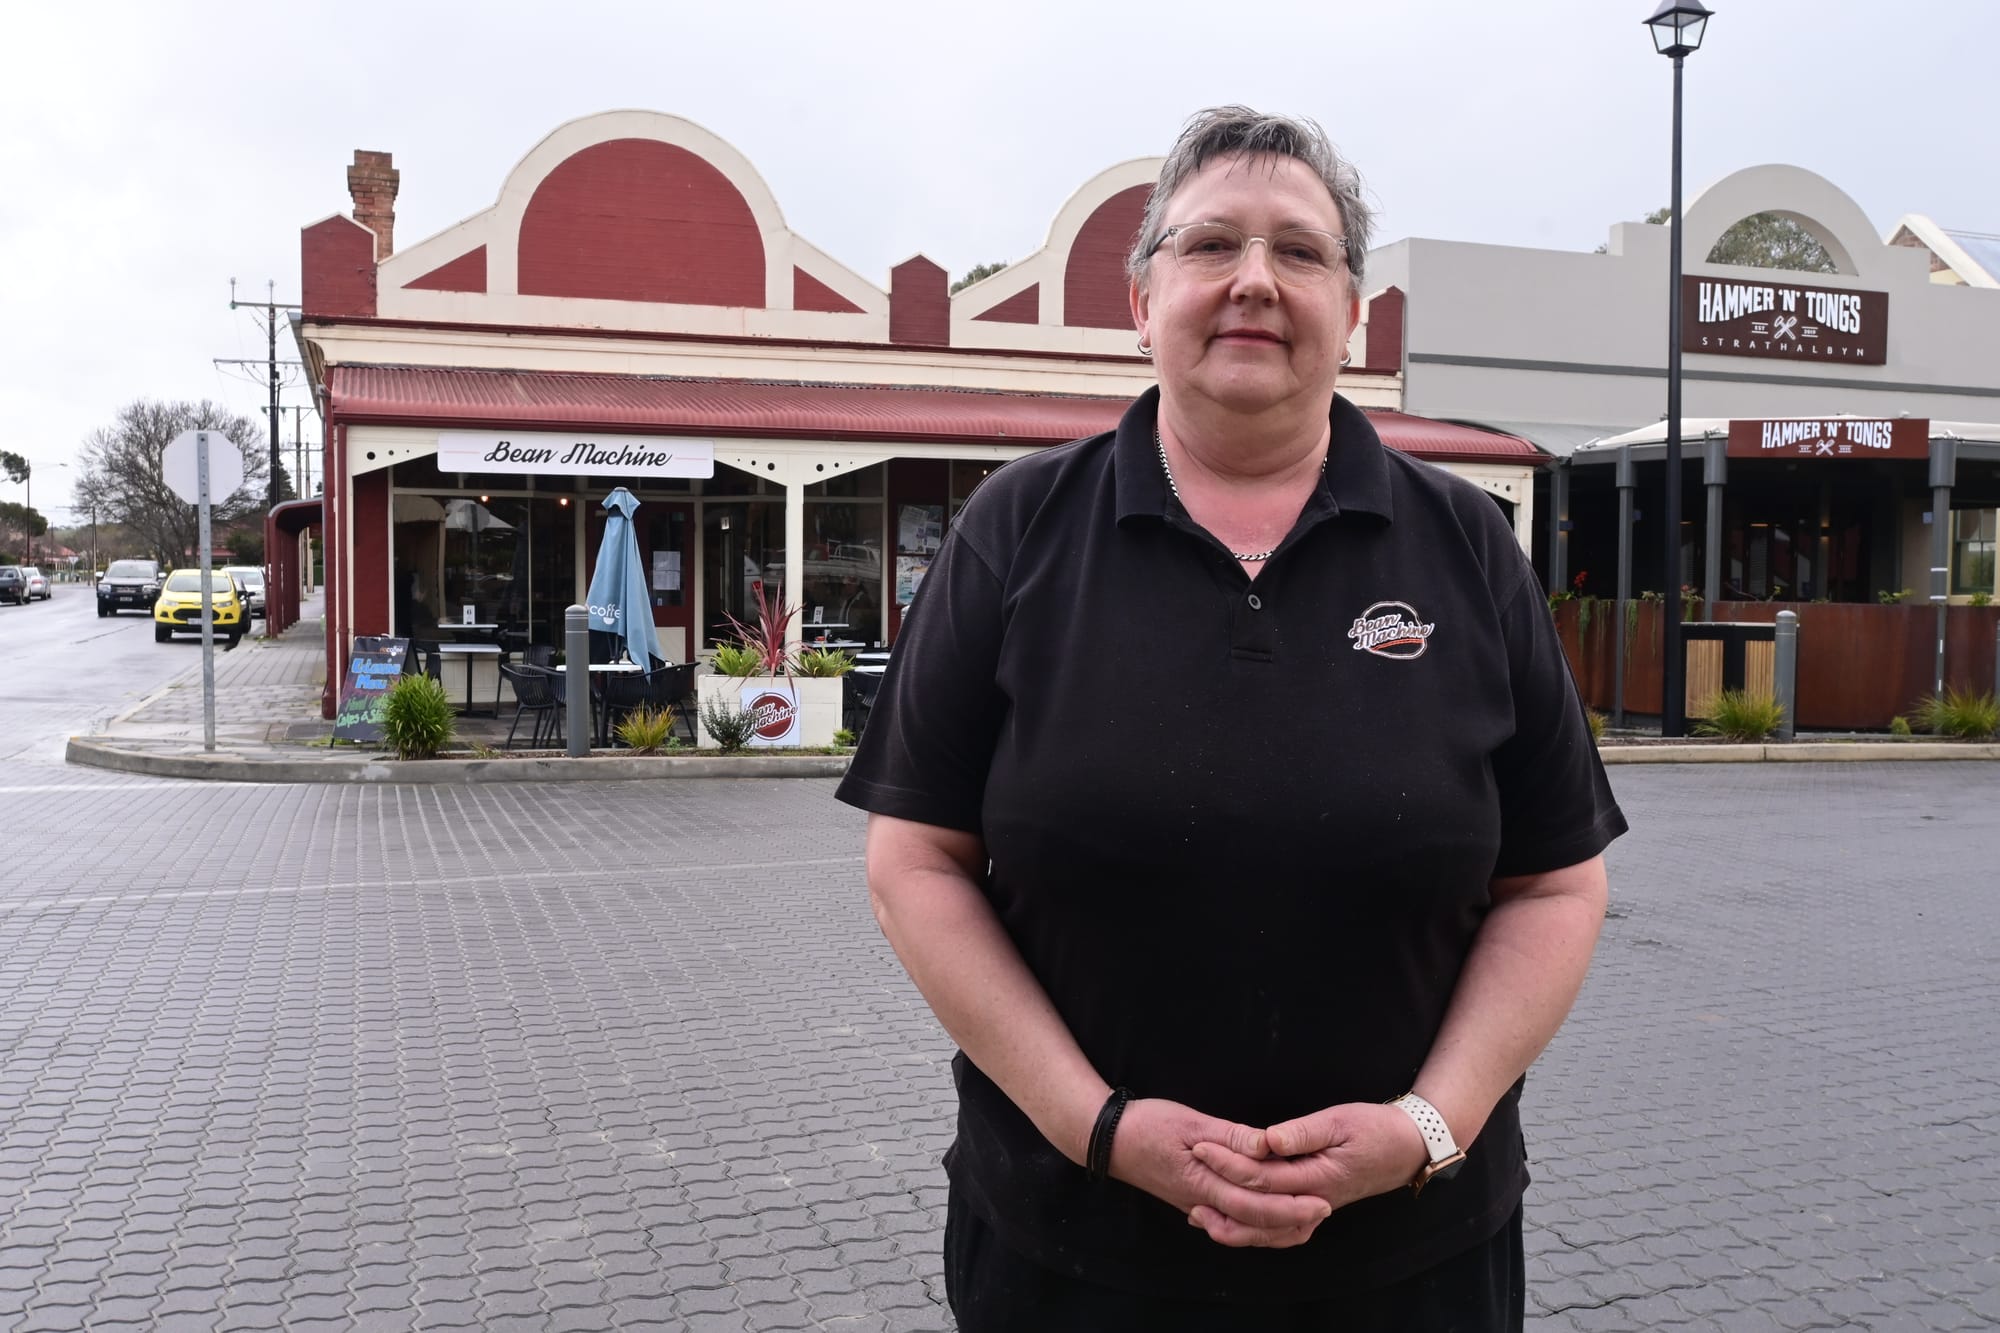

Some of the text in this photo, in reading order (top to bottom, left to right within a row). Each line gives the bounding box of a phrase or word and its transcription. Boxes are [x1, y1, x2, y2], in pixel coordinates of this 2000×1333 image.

[1698, 282, 1775, 322] HAMMER
[1805, 291, 1861, 334] TONGS
[1702, 336, 1864, 357] STRATHALBYN
[1761, 421, 1821, 449] HAMMER
[1846, 421, 1892, 449] TONGS
[484, 441, 673, 467] Bean Machine
[1347, 613, 1402, 638] Bean
[1352, 621, 1435, 650] Machine
